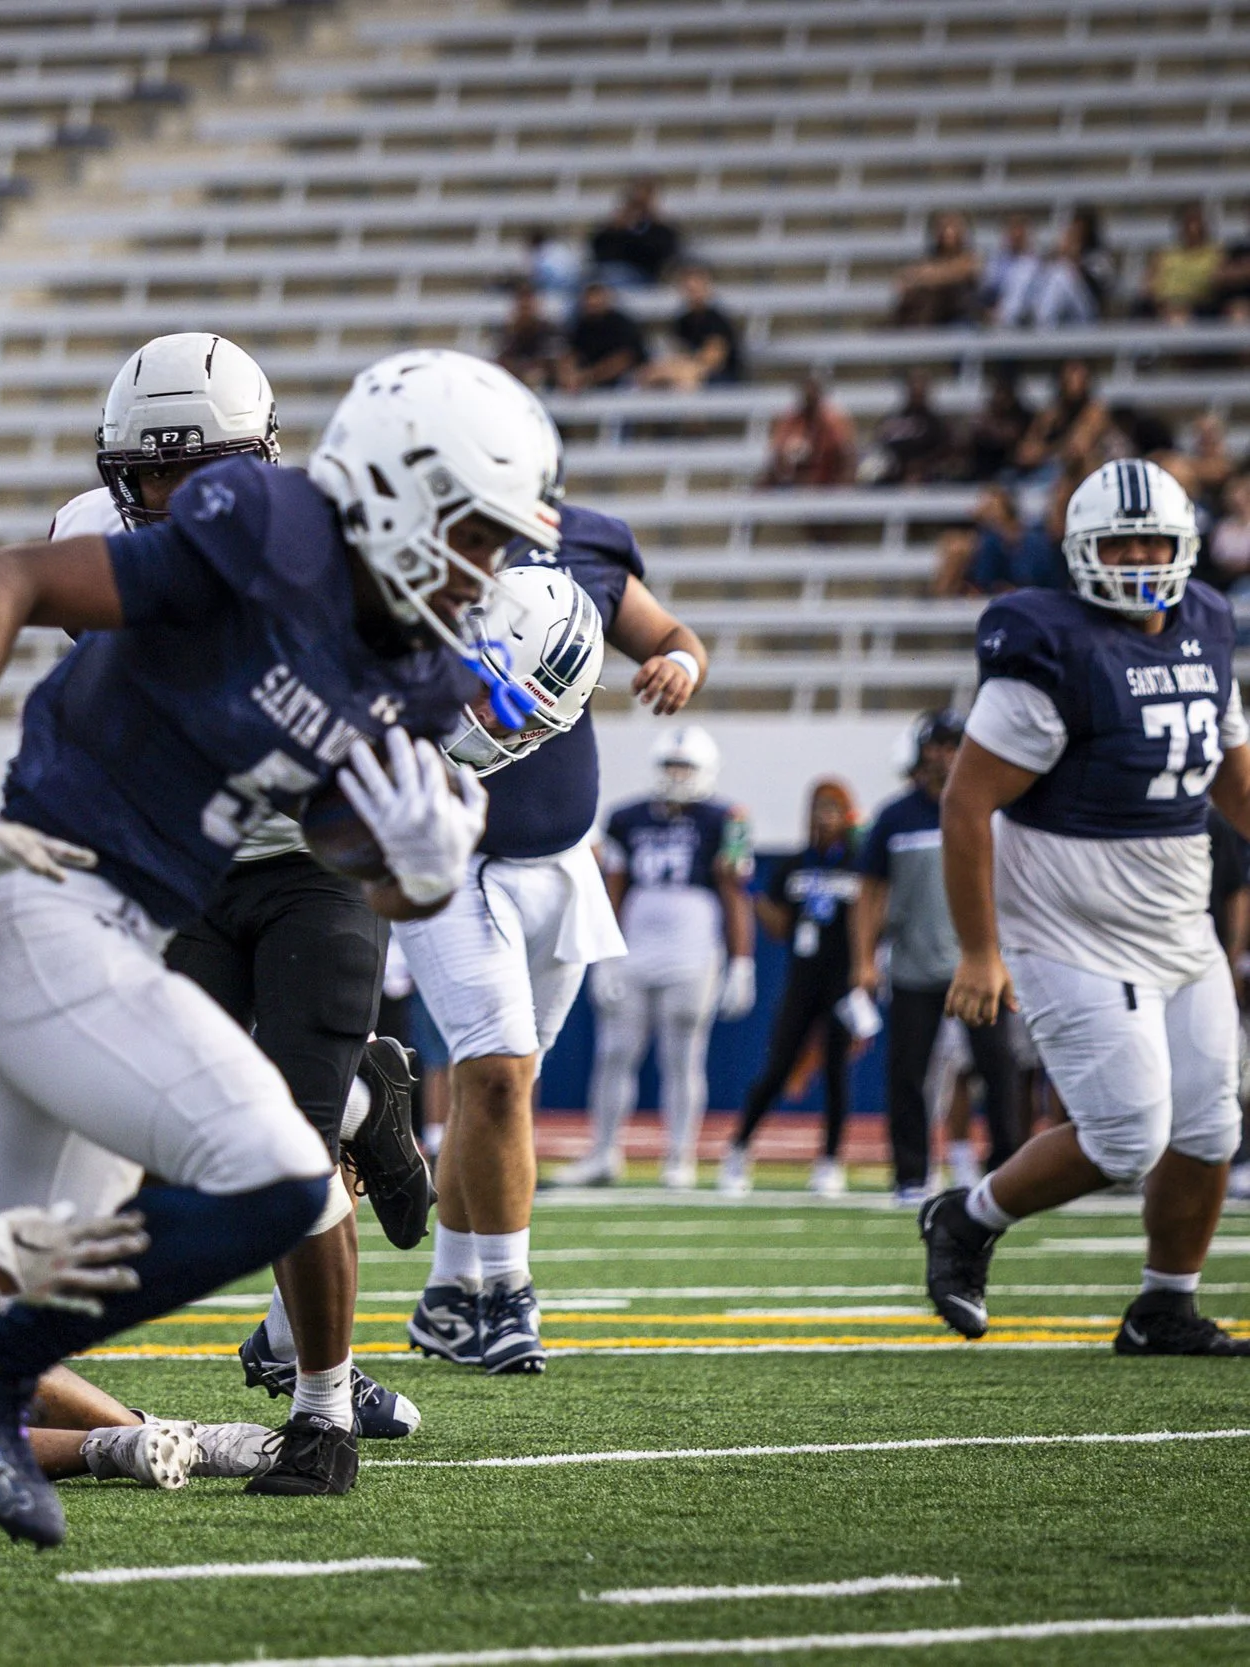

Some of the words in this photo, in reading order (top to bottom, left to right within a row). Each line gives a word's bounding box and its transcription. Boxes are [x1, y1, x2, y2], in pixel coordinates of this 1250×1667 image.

[251, 663, 330, 749] SANTA
[524, 681, 556, 708] Riddell
[1126, 665, 1177, 697] SANTA
[1141, 698, 1225, 800] 73
